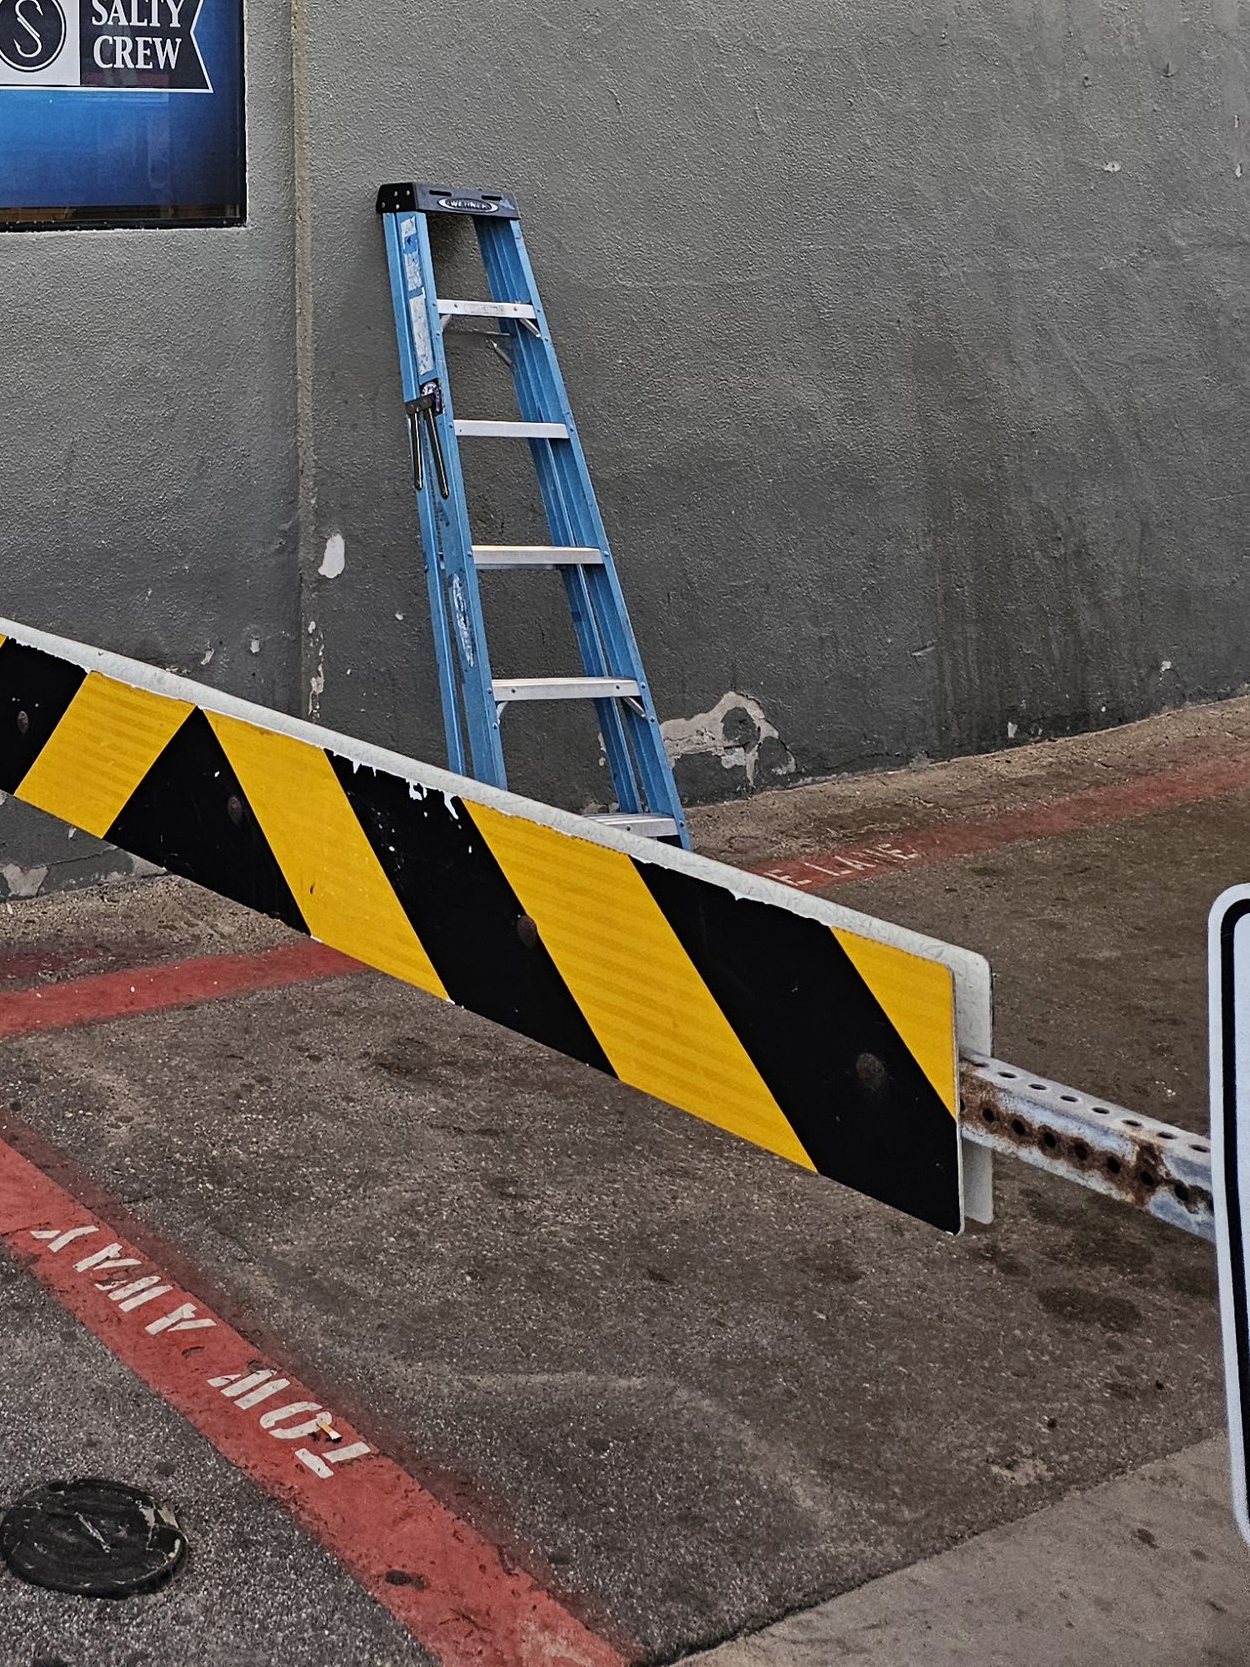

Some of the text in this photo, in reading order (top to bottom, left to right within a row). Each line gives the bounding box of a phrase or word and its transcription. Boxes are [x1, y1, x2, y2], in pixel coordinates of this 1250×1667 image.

[92, 34, 183, 70] CREW
[803, 843, 921, 877] LANE
[29, 1224, 372, 1480] TOW AWAY
